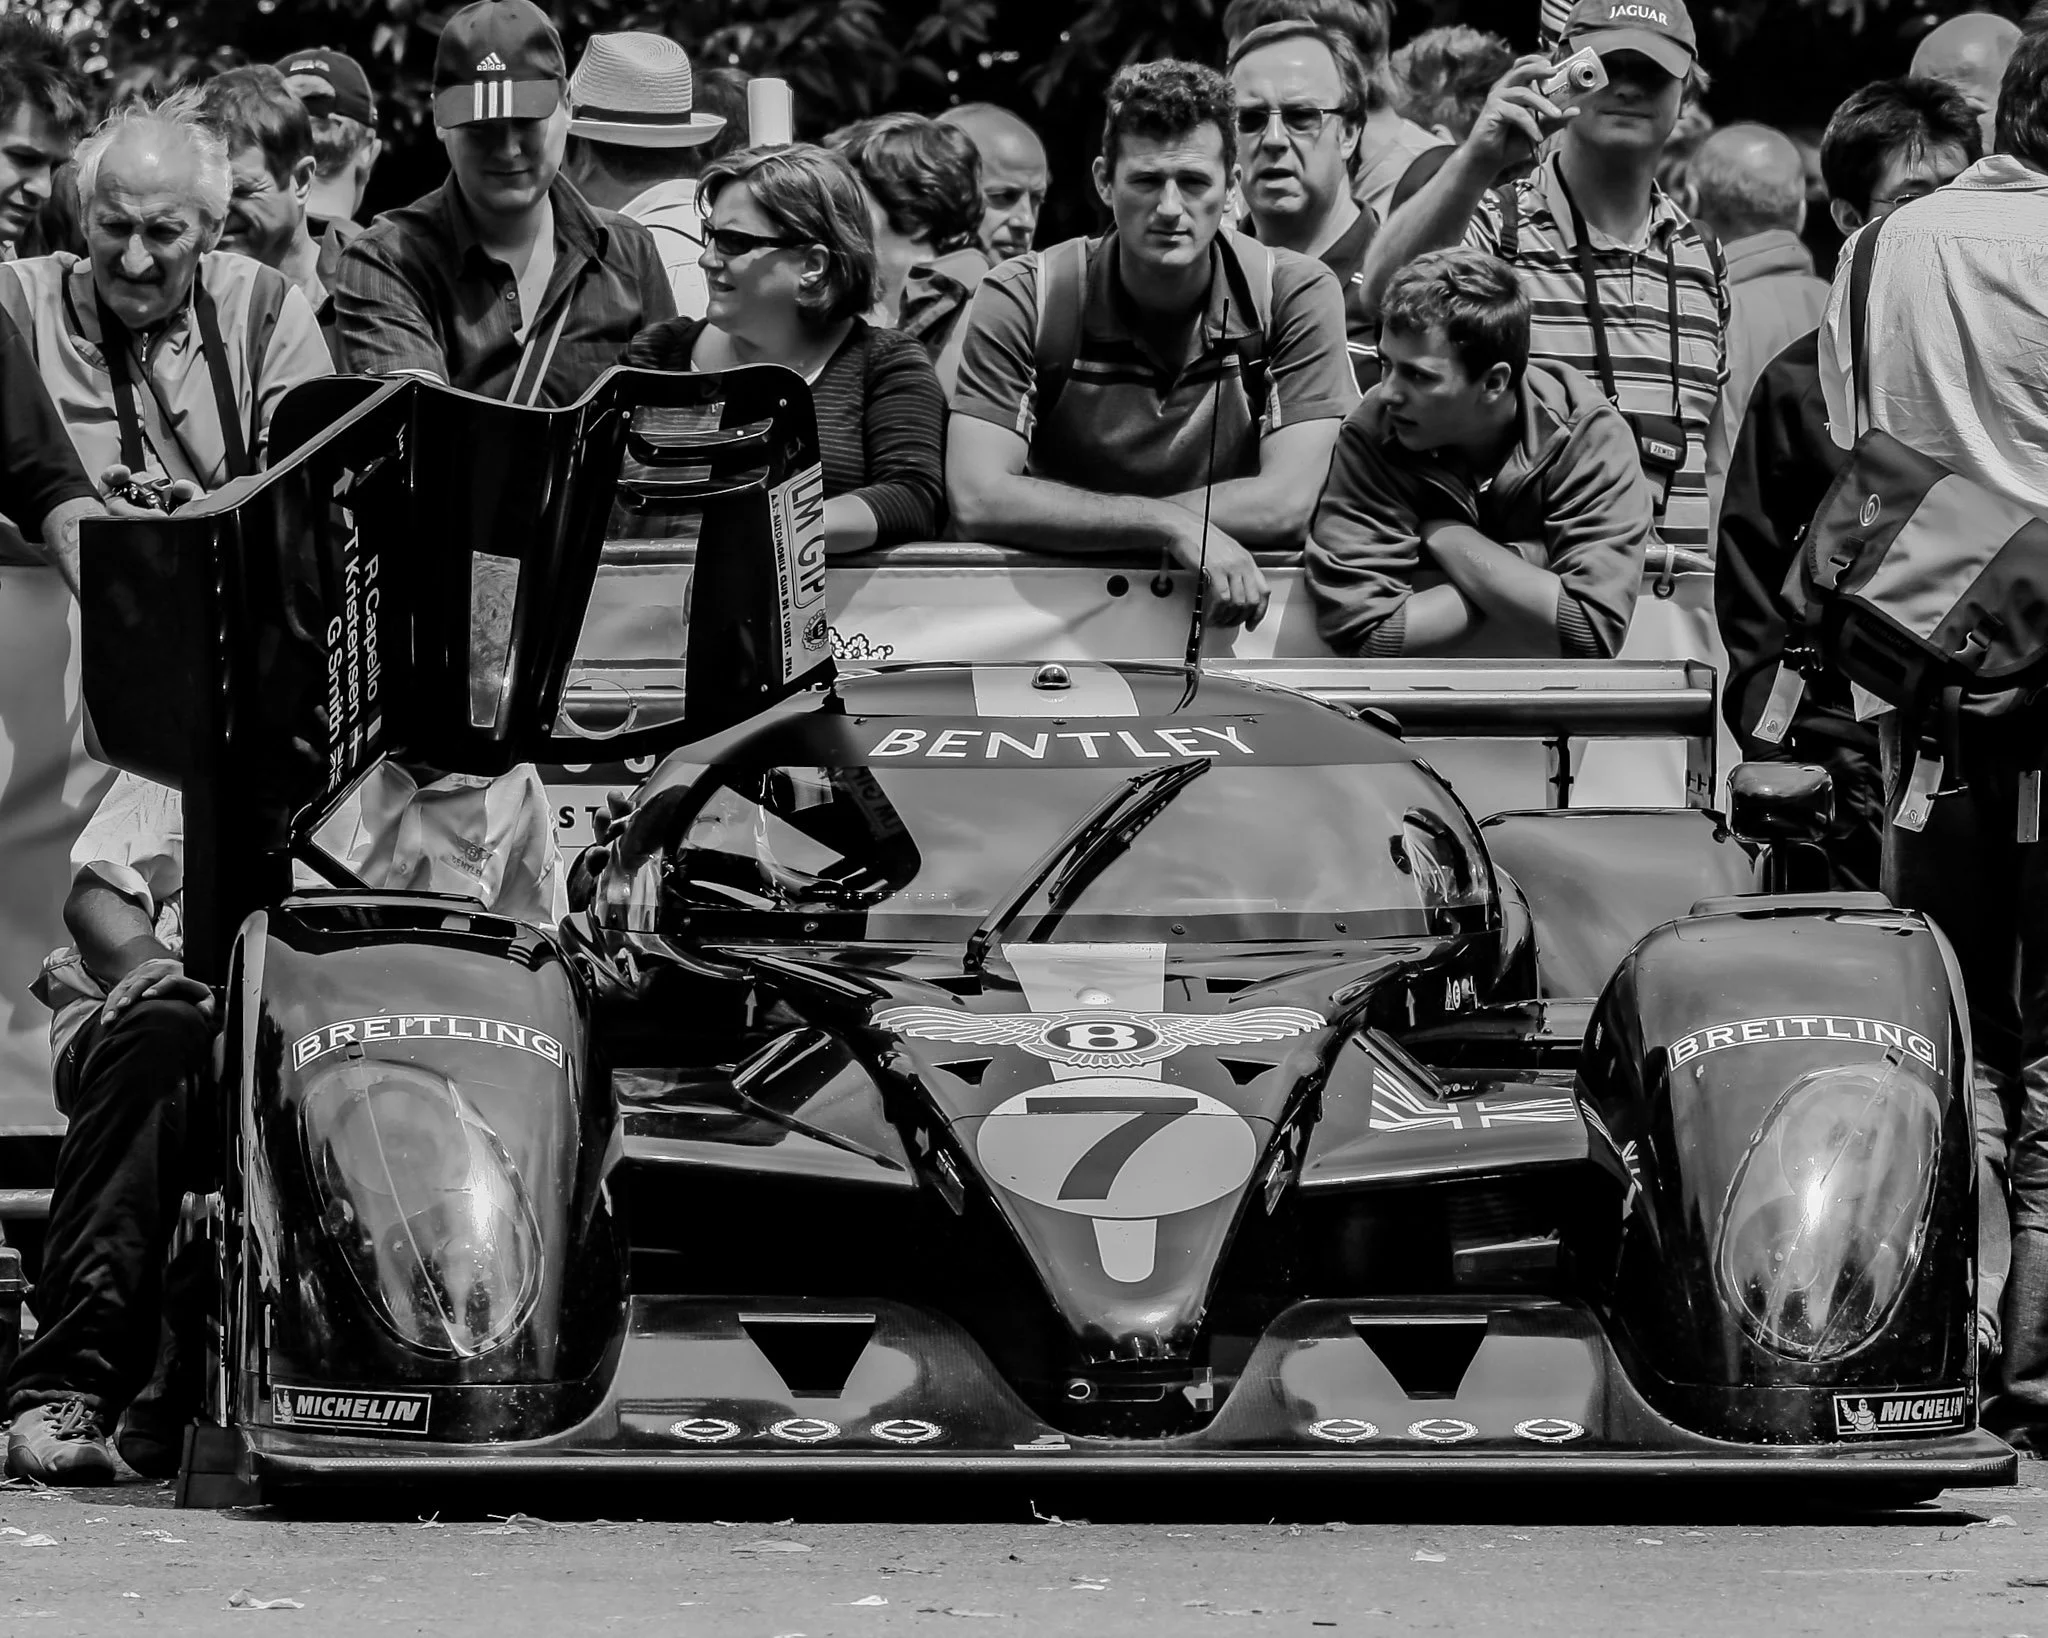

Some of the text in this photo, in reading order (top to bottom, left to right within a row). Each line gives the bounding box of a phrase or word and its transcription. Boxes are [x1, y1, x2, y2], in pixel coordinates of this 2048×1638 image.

[1609, 5, 1668, 26] JAGUAR
[476, 63, 506, 71] adidas
[791, 474, 824, 534] LM
[773, 514, 787, 573] AUTOMOBILE
[780, 574, 789, 598] CLUB
[782, 598, 790, 612] DE
[344, 526, 361, 723] T Kristensen
[364, 554, 381, 701] R Capello
[782, 612, 792, 649] L'OUEST
[327, 616, 344, 744] G Smith
[867, 726, 1255, 759] BENTLEY
[297, 1017, 560, 1065] BREITLING
[1064, 1024, 1138, 1048] B
[1673, 1018, 1934, 1065] BREITLING
[1025, 1096, 1199, 1201] 7
[296, 1394, 422, 1422] MICHELIN
[1879, 1396, 1964, 1422] MICHELIN
